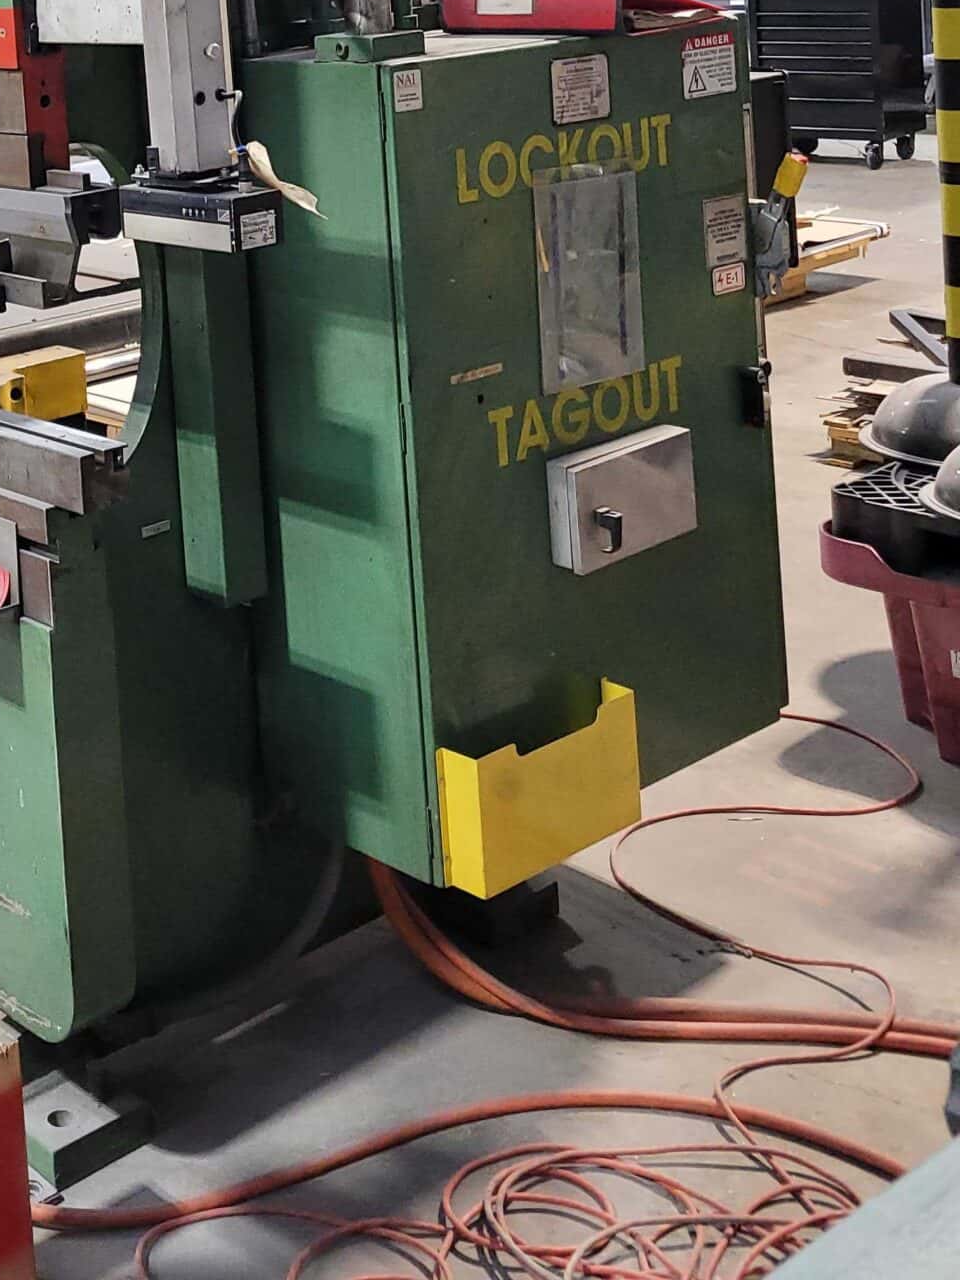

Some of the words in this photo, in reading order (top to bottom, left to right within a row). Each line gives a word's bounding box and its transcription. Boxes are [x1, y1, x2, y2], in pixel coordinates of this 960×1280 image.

[694, 33, 729, 48] DANGER
[455, 113, 672, 204] LOCKOUT
[488, 354, 682, 468] TAGOUT
